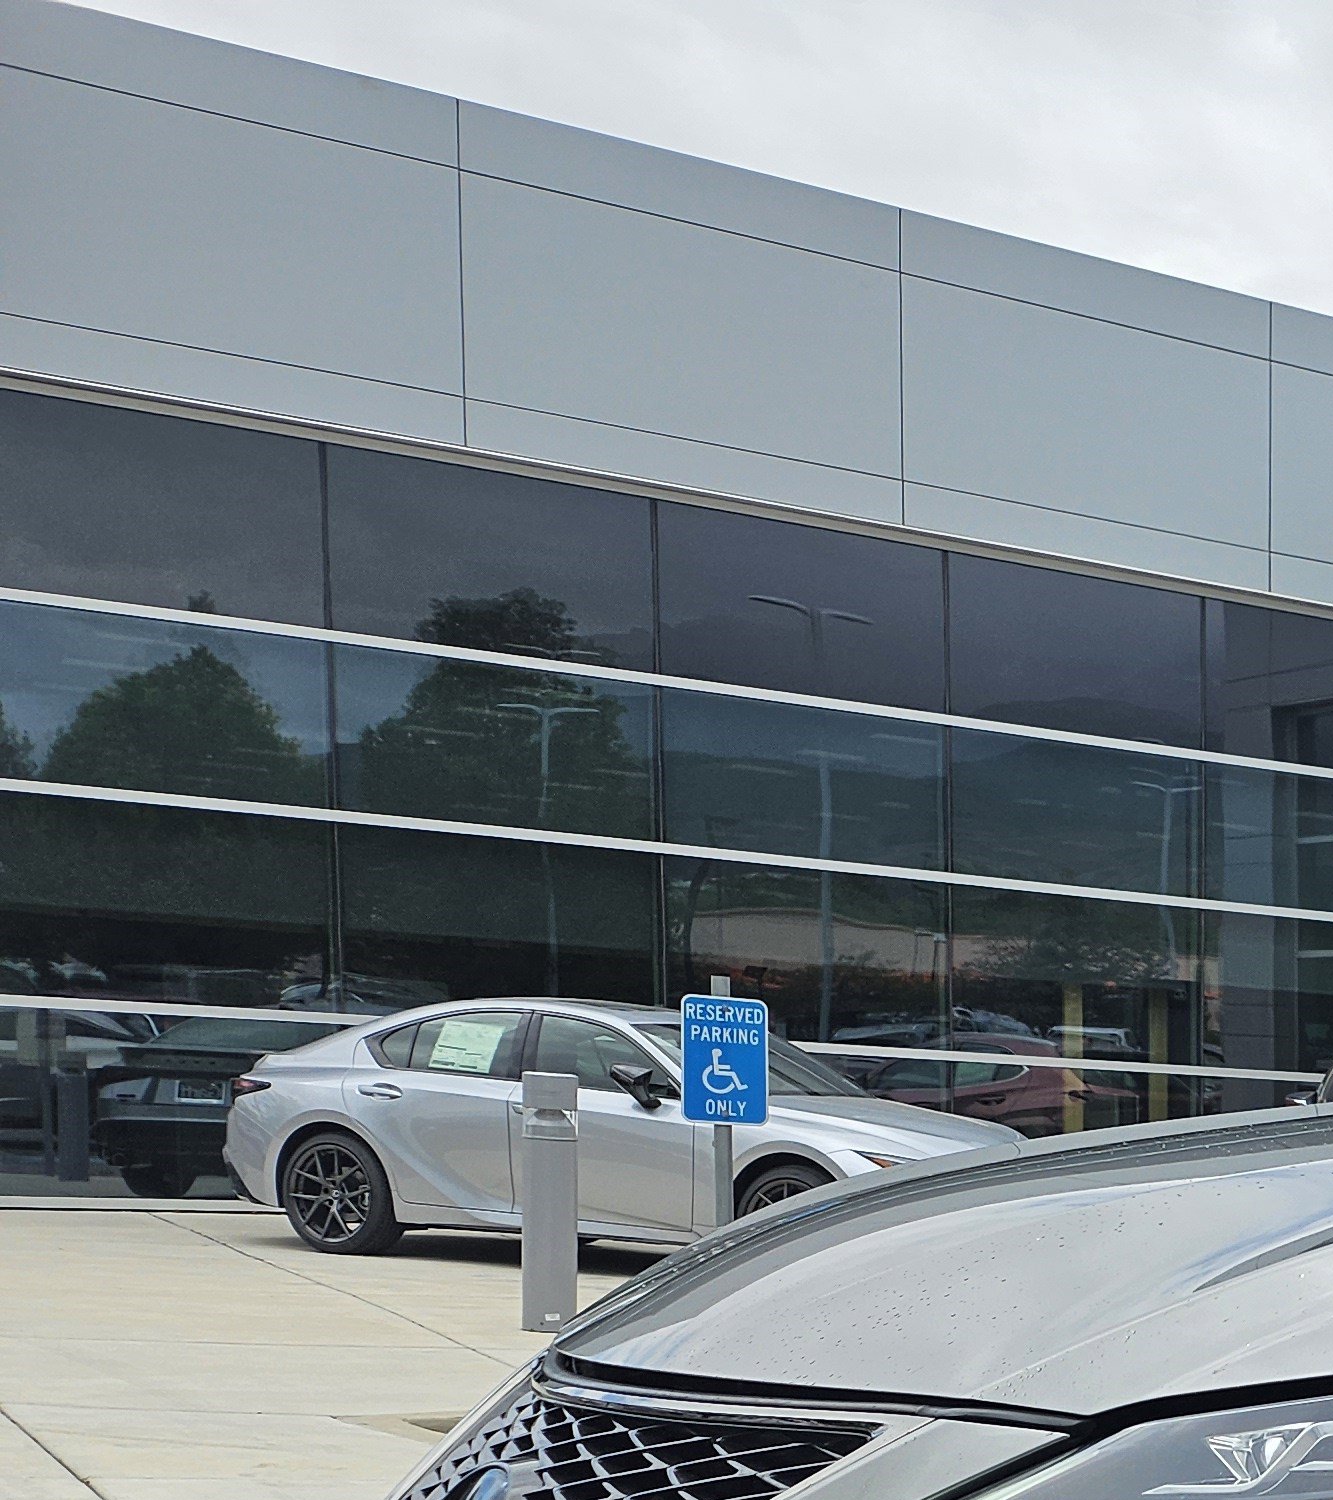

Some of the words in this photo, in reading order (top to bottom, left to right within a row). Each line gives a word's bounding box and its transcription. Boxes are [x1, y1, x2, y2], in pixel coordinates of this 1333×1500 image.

[686, 1003, 763, 1024] RESERVED
[691, 1025, 759, 1045] PARKING
[705, 1100, 747, 1117] ONLY
